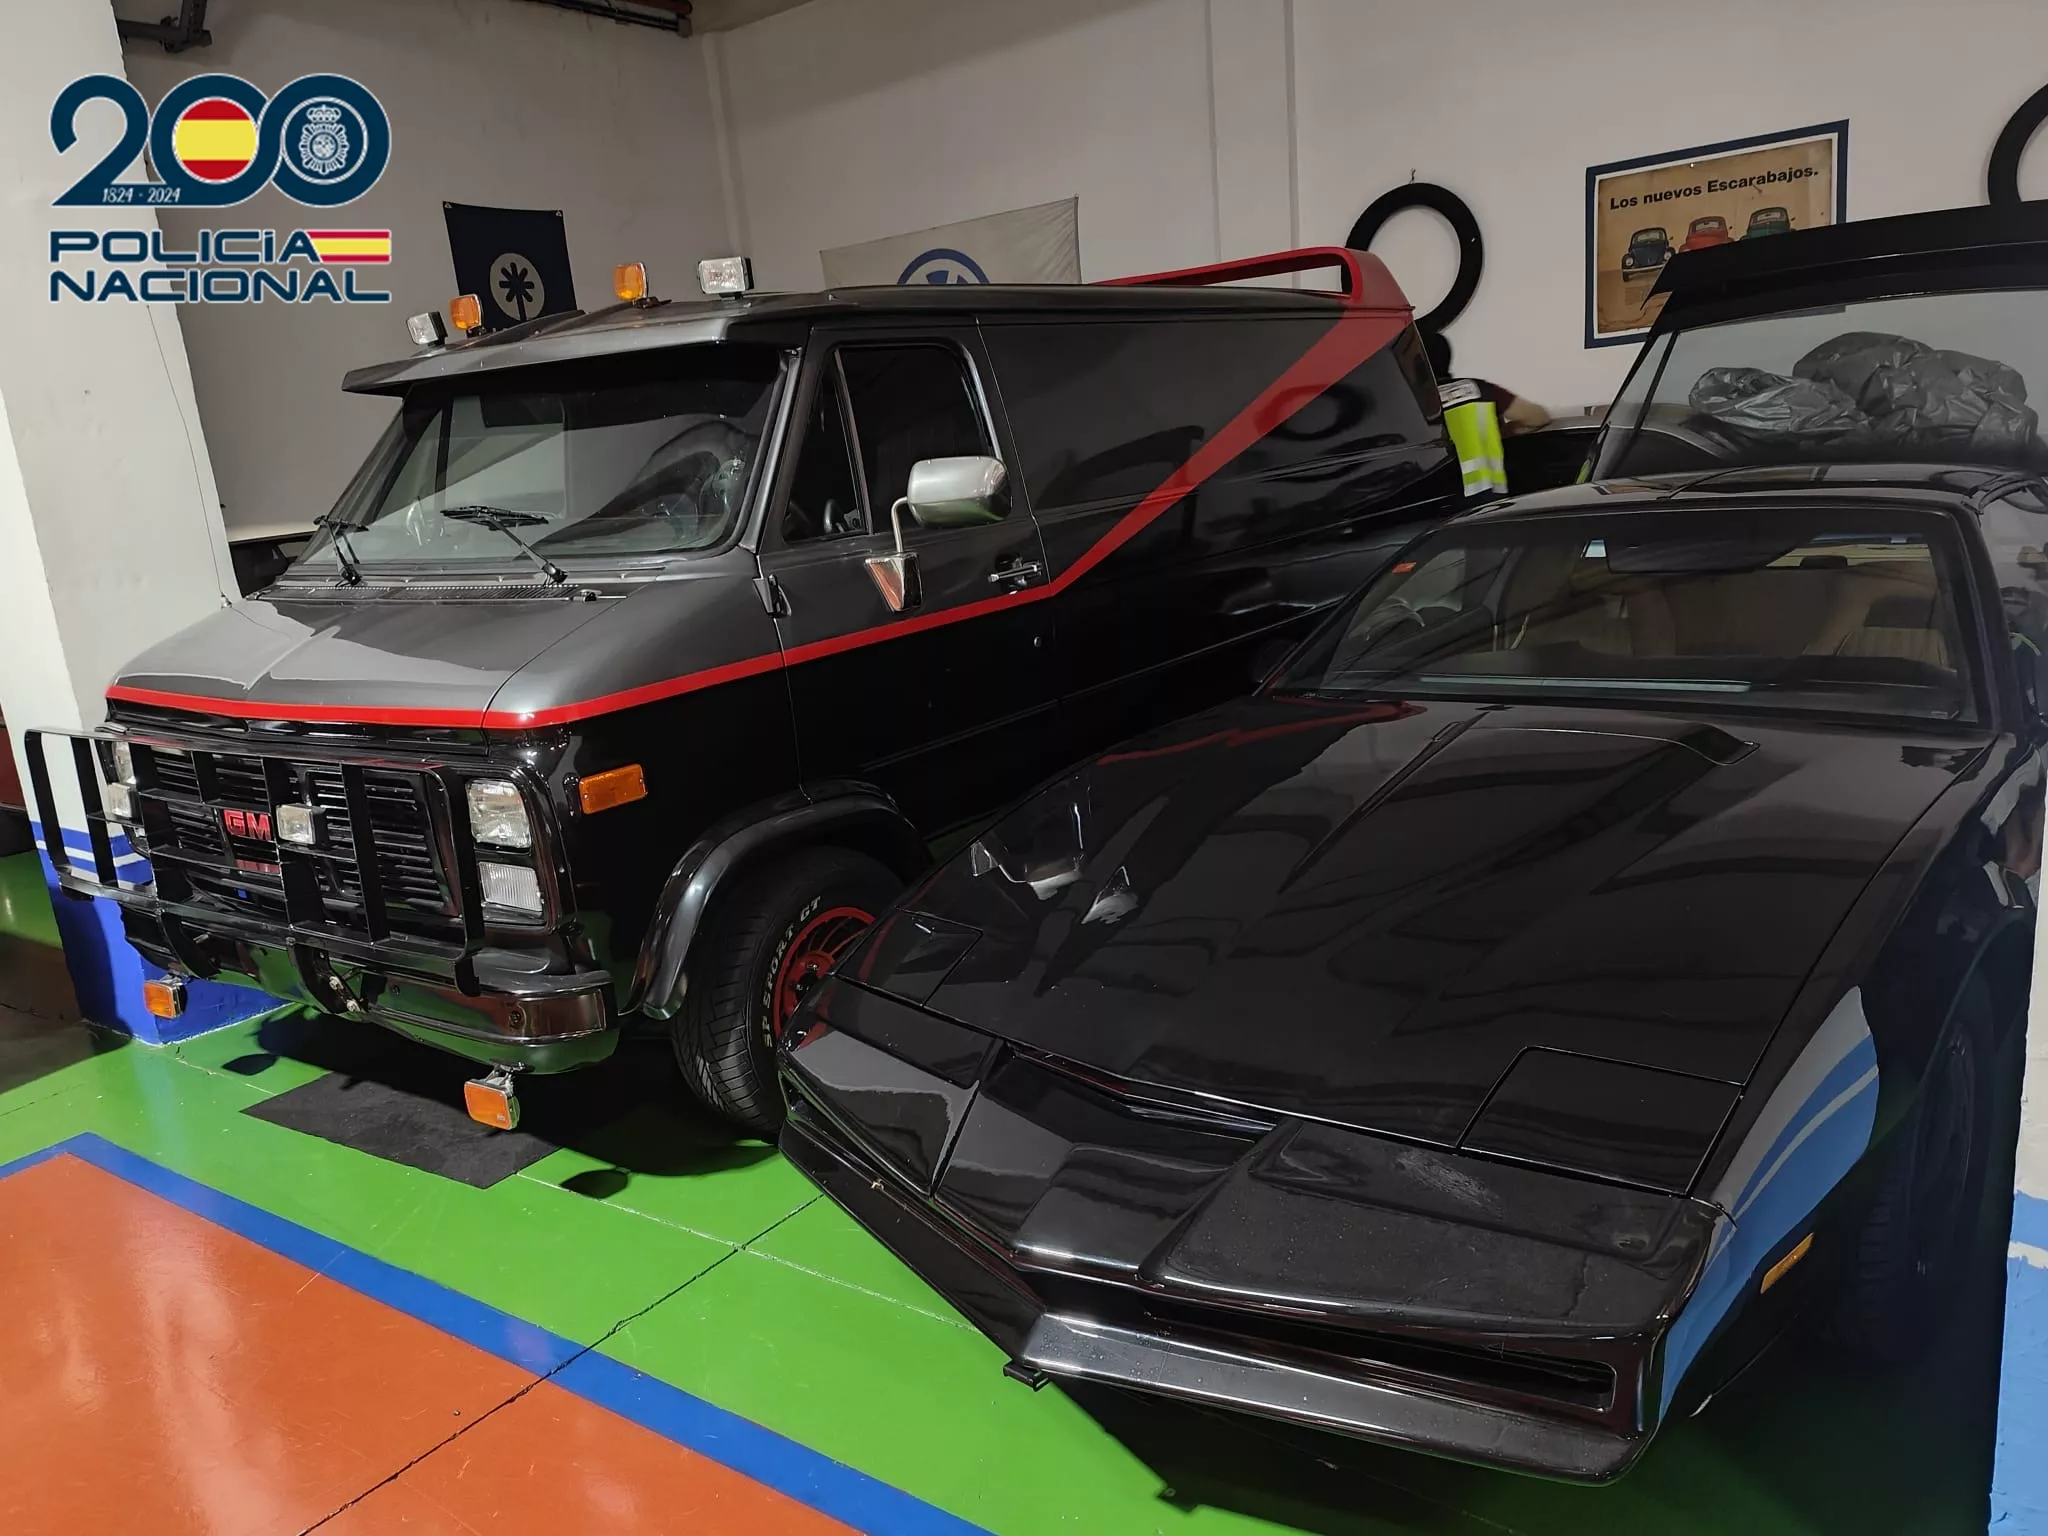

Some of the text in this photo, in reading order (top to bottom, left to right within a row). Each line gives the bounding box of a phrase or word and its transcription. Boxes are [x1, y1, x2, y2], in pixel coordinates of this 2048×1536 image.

[1610, 166, 1819, 210] Los nuevos Escarabajos.
[223, 809, 272, 841] GM
[763, 921, 794, 1009] SPORT
